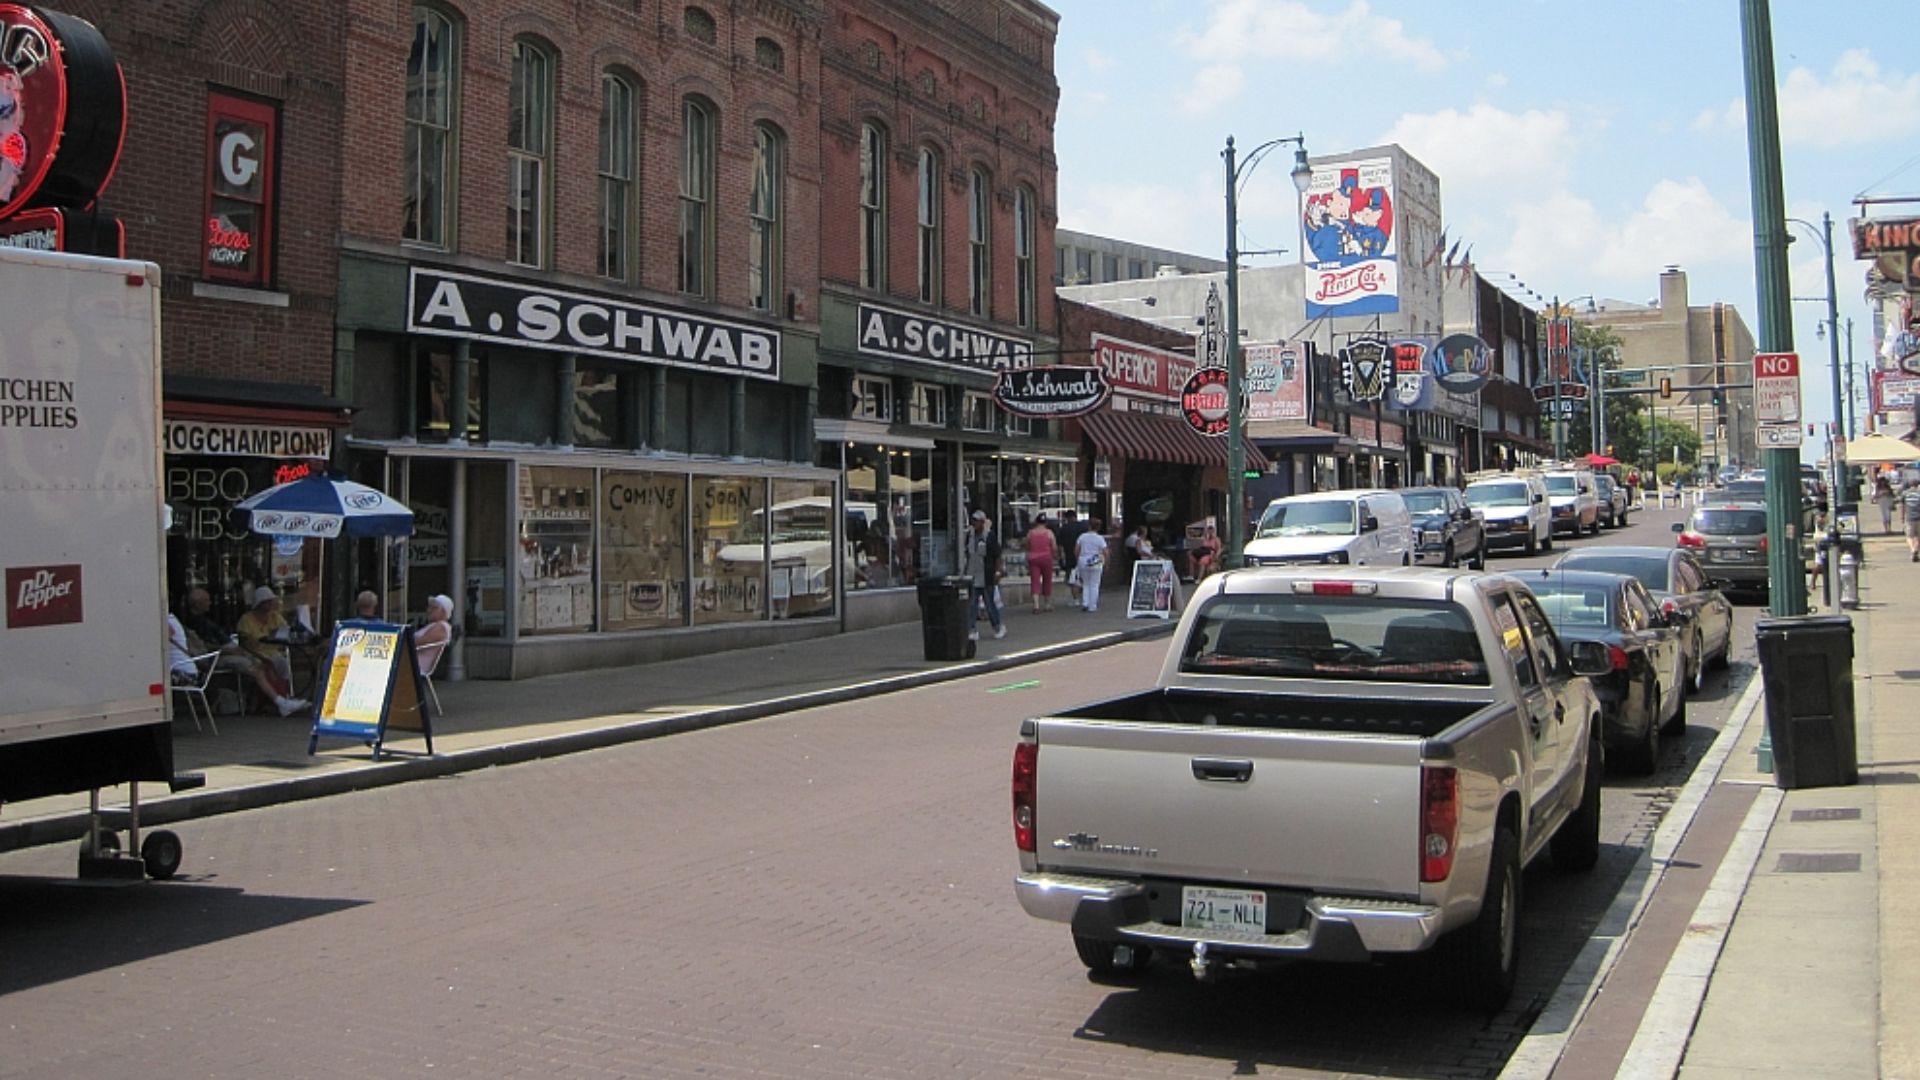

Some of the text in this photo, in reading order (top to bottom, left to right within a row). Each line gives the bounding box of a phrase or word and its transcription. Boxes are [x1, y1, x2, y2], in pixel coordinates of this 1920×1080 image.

[220, 131, 258, 186] G
[516, 294, 773, 370] SCHWAB
[1101, 345, 1158, 388] SUPERIOR
[1762, 357, 1790, 374] NO
[1022, 371, 1099, 397] Schwab
[168, 466, 250, 501] BBQ
[17, 579, 74, 610] Pepper
[36, 569, 56, 588] Dr
